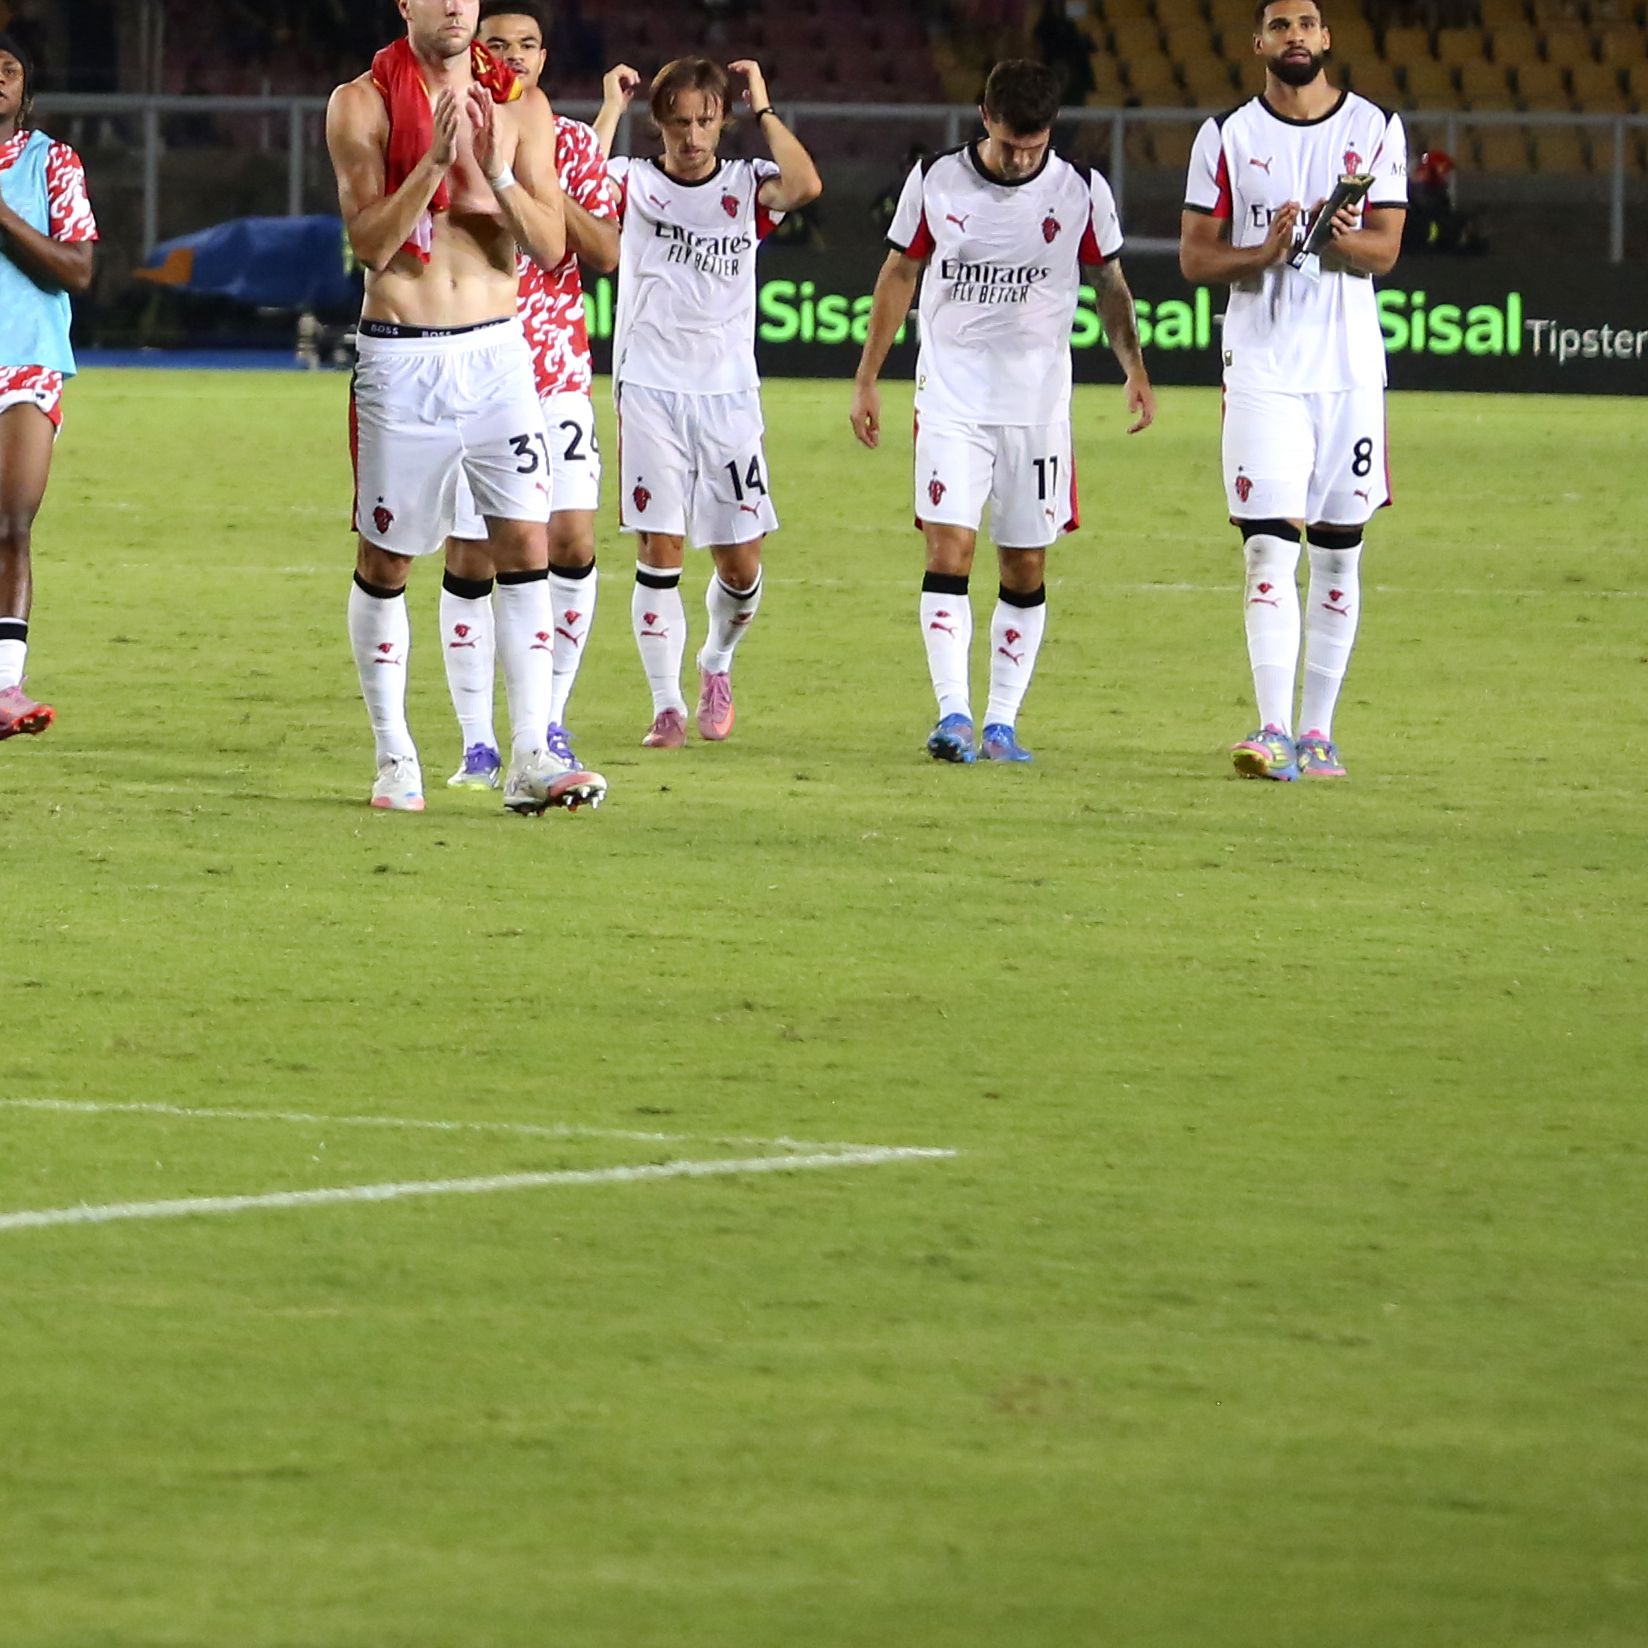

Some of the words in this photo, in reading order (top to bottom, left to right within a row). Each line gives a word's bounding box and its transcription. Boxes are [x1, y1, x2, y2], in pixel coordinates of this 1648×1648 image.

[667, 243, 693, 265] FLY
[941, 258, 1051, 285] Emirates
[954, 283, 974, 303] FLY
[370, 324, 399, 336] BOSS
[1375, 288, 1523, 357] Sisal
[508, 432, 551, 476] 31
[1351, 436, 1373, 477] 8
[725, 454, 767, 501] 14
[1032, 455, 1059, 500] 11
